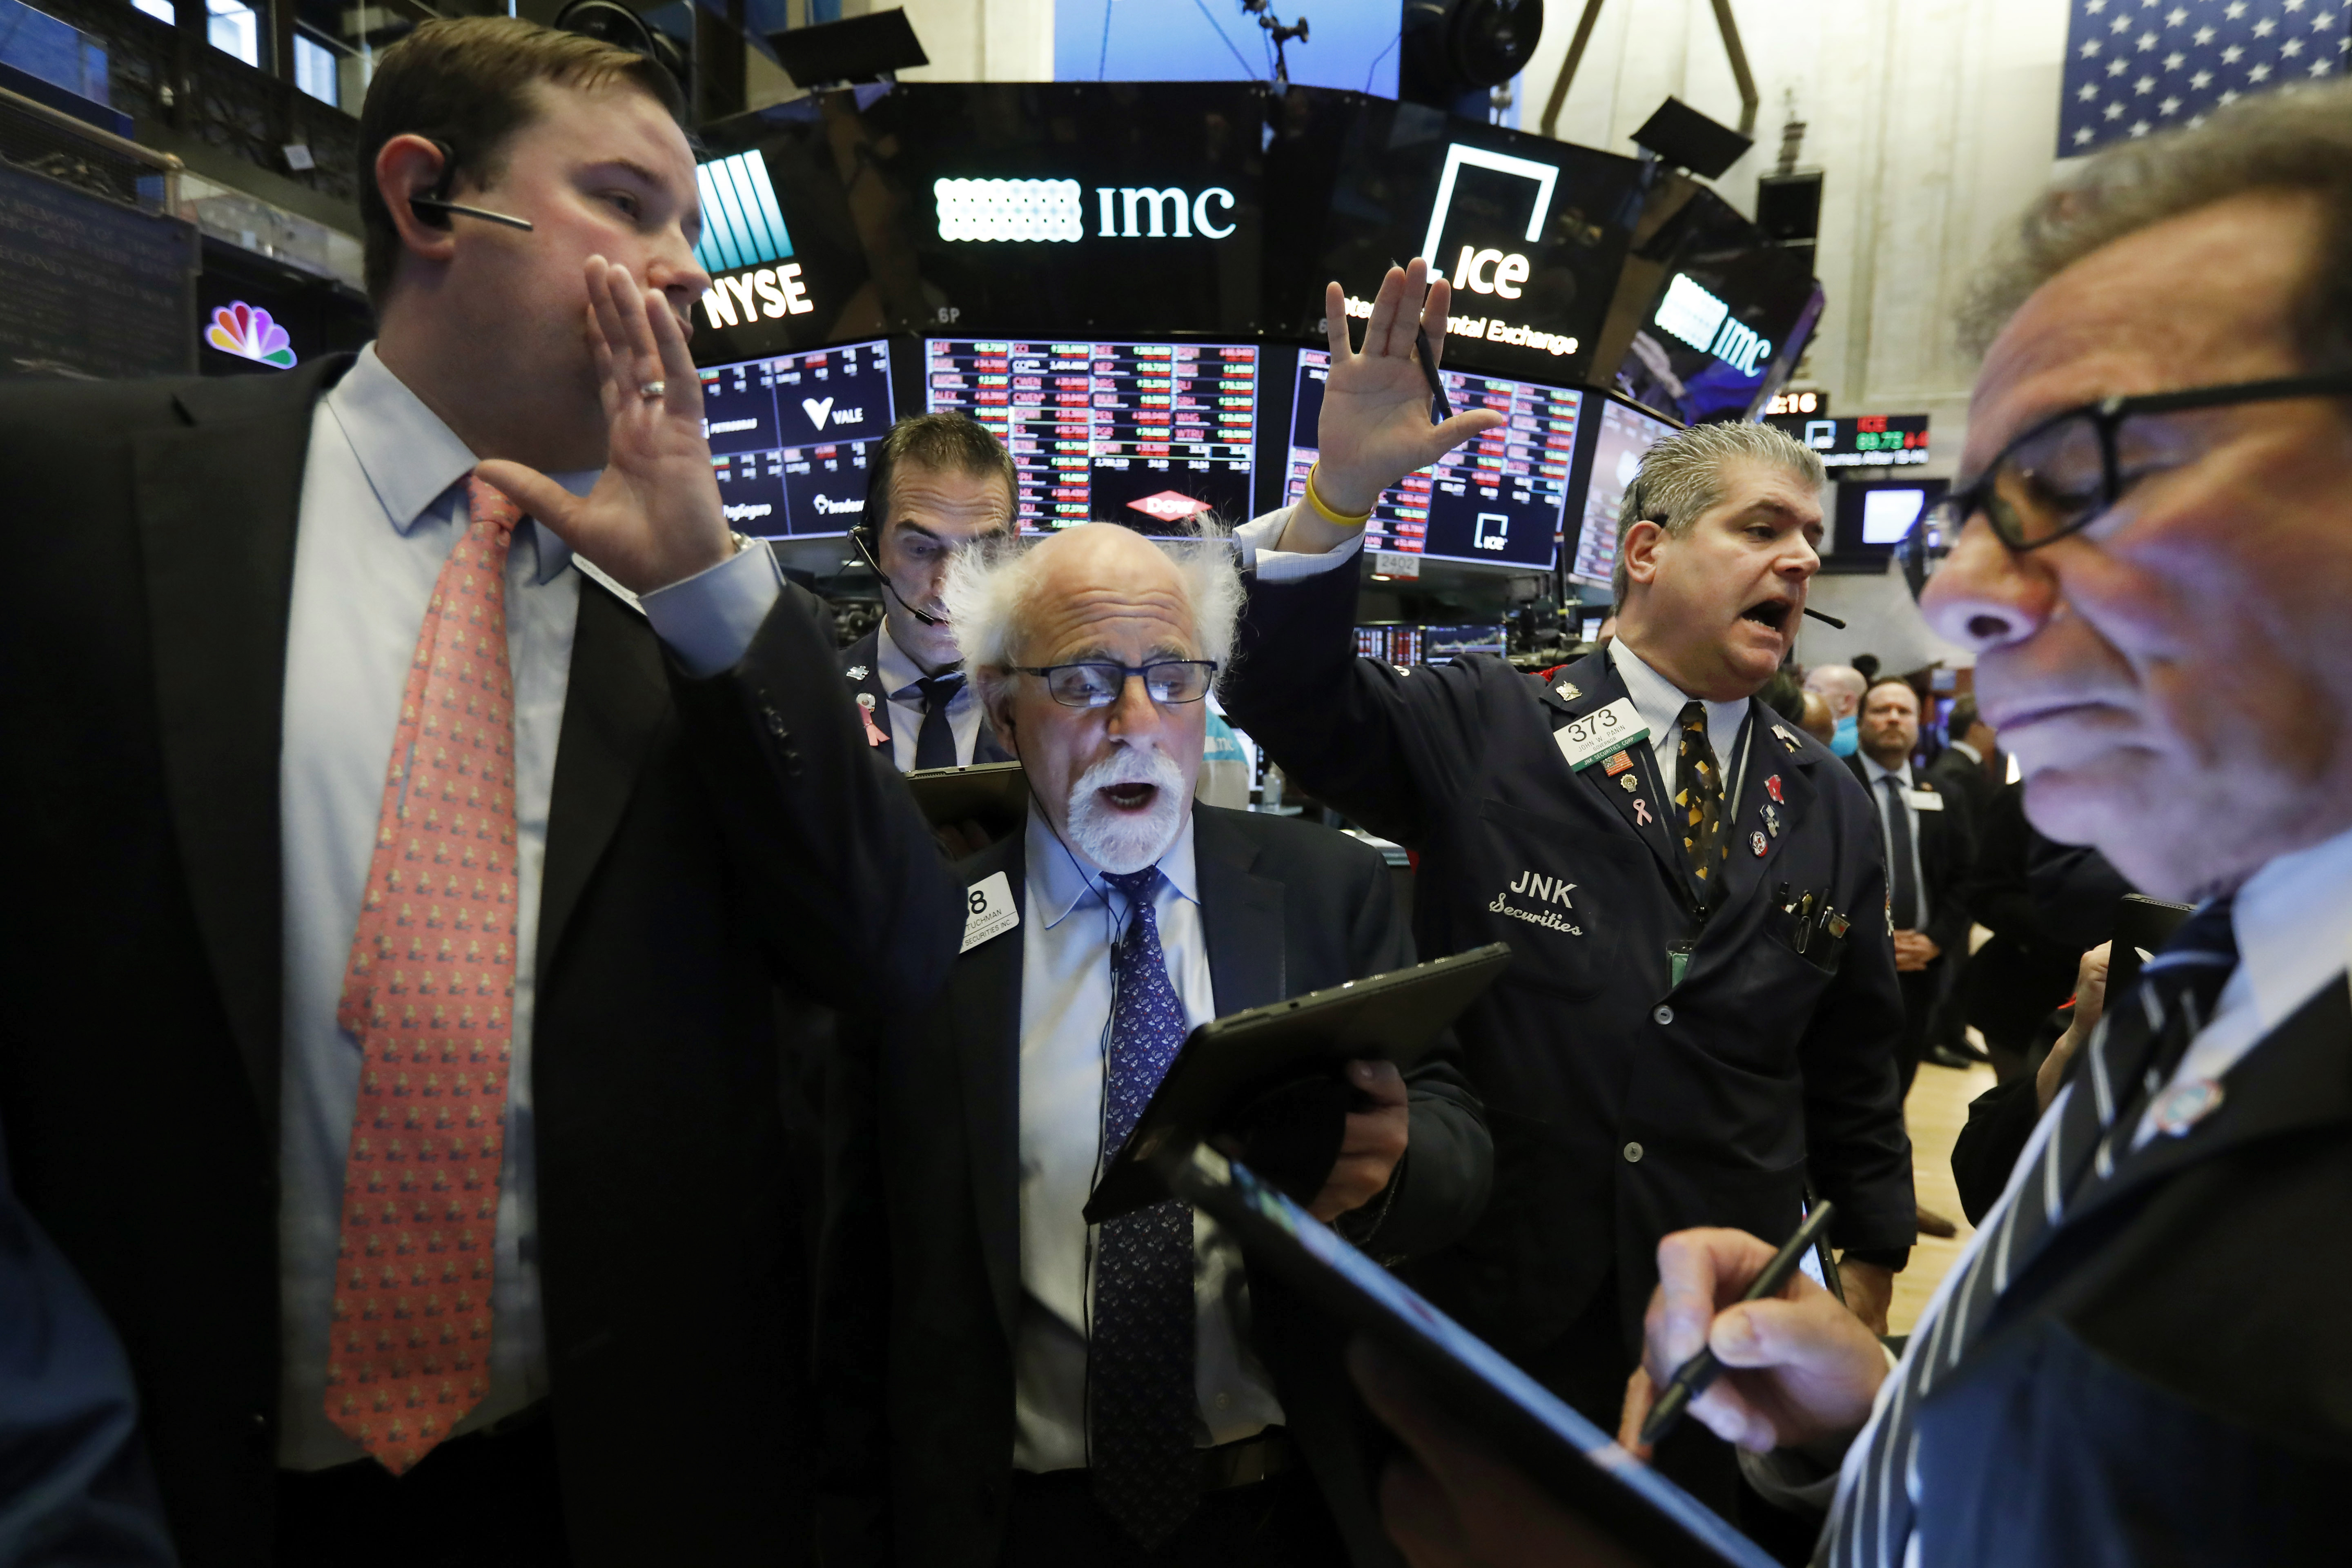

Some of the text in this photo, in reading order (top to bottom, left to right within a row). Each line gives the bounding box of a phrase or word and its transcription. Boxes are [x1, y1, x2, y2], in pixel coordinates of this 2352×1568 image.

[701, 263, 814, 329] NYSE
[1486, 319, 1579, 356] Exchange
[1147, 497, 1196, 514] DOW
[1568, 709, 1617, 742] 373
[1578, 740, 1595, 753] JOHN
[1606, 724, 1626, 737] PANIN
[1592, 737, 1617, 752] GOVERNOR
[1594, 744, 1621, 760] SECURITIES
[1510, 871, 1578, 909] JNK
[965, 908, 1002, 931] TUCHMAN
[1489, 893, 1583, 936] Securities
[964, 919, 1013, 947] SECURITIES INC.
